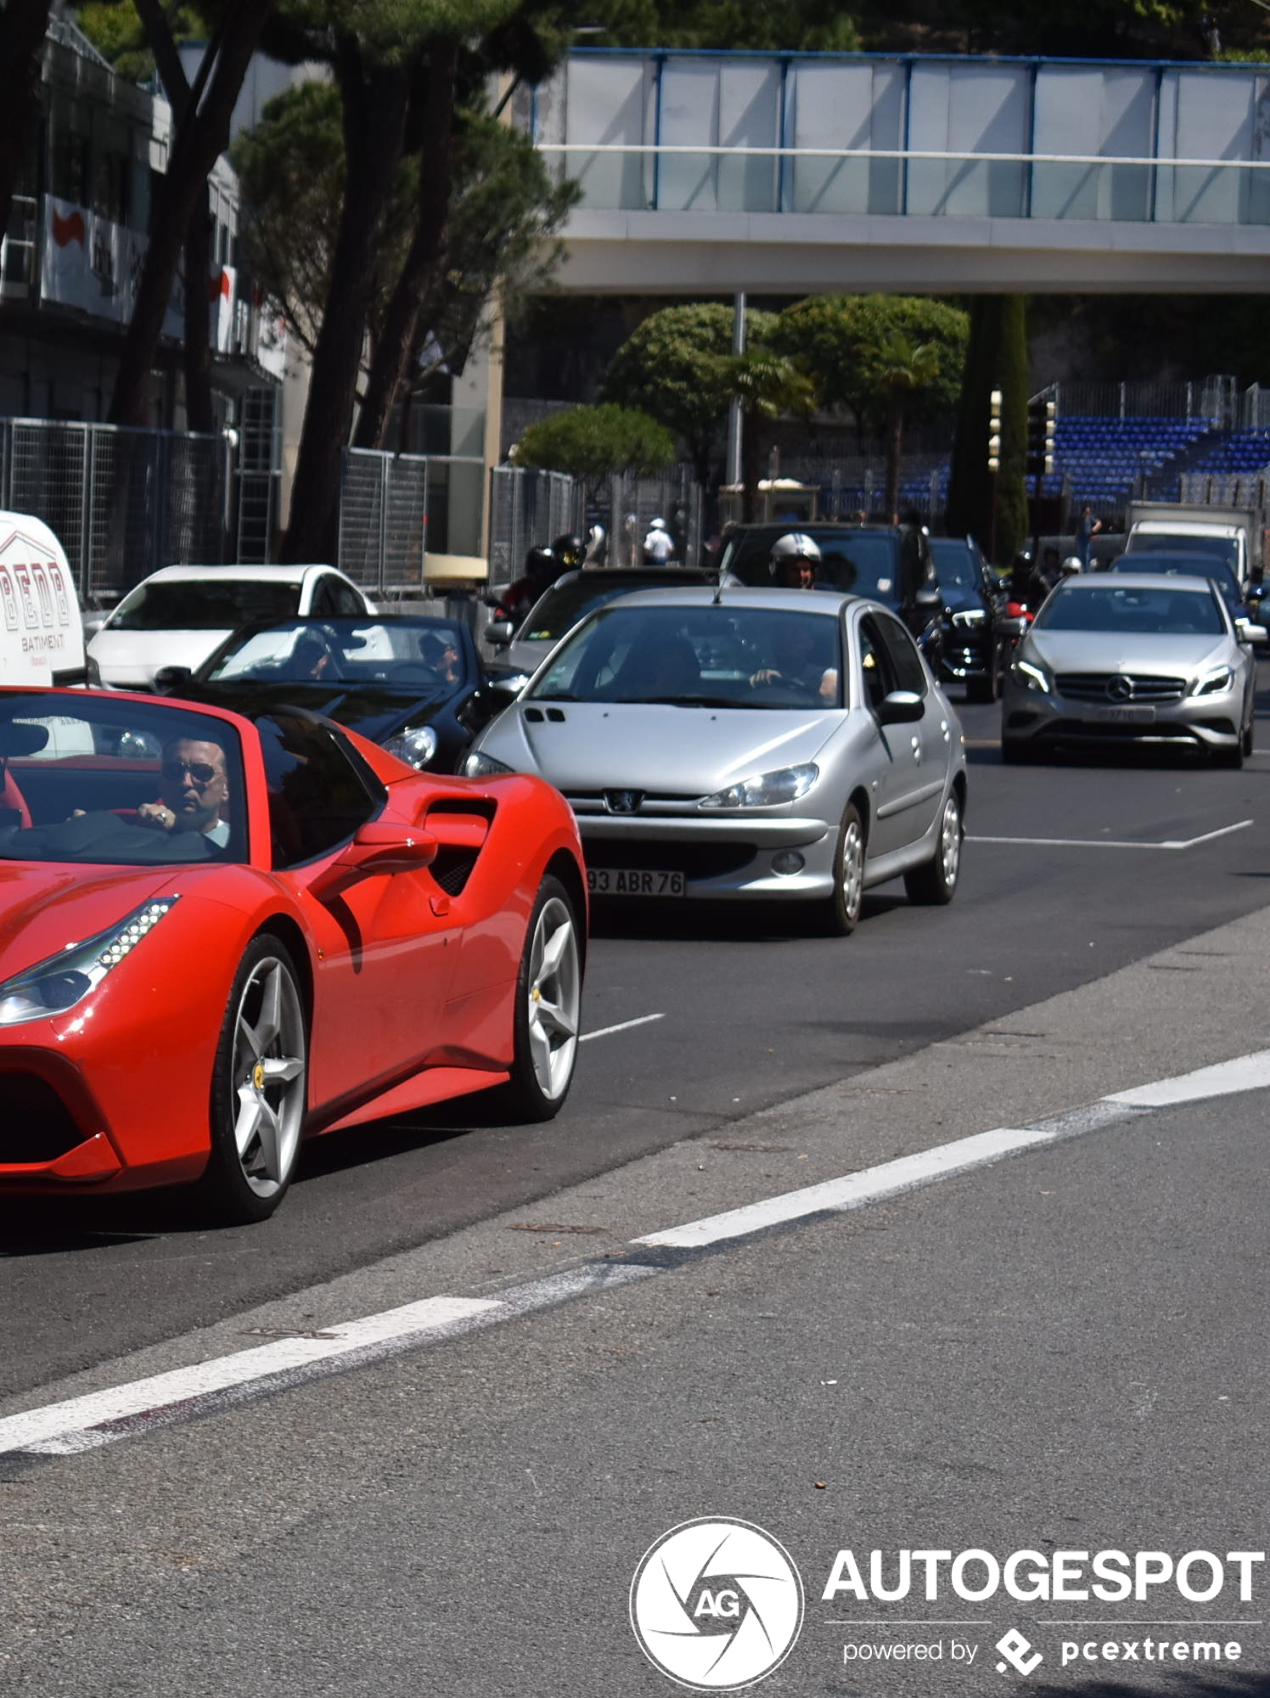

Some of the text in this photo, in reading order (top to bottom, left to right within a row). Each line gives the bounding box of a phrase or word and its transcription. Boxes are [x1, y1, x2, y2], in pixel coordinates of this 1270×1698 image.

[21, 634, 63, 652] BATIMENT
[616, 871, 653, 893] ABR
[658, 873, 682, 894] 76
